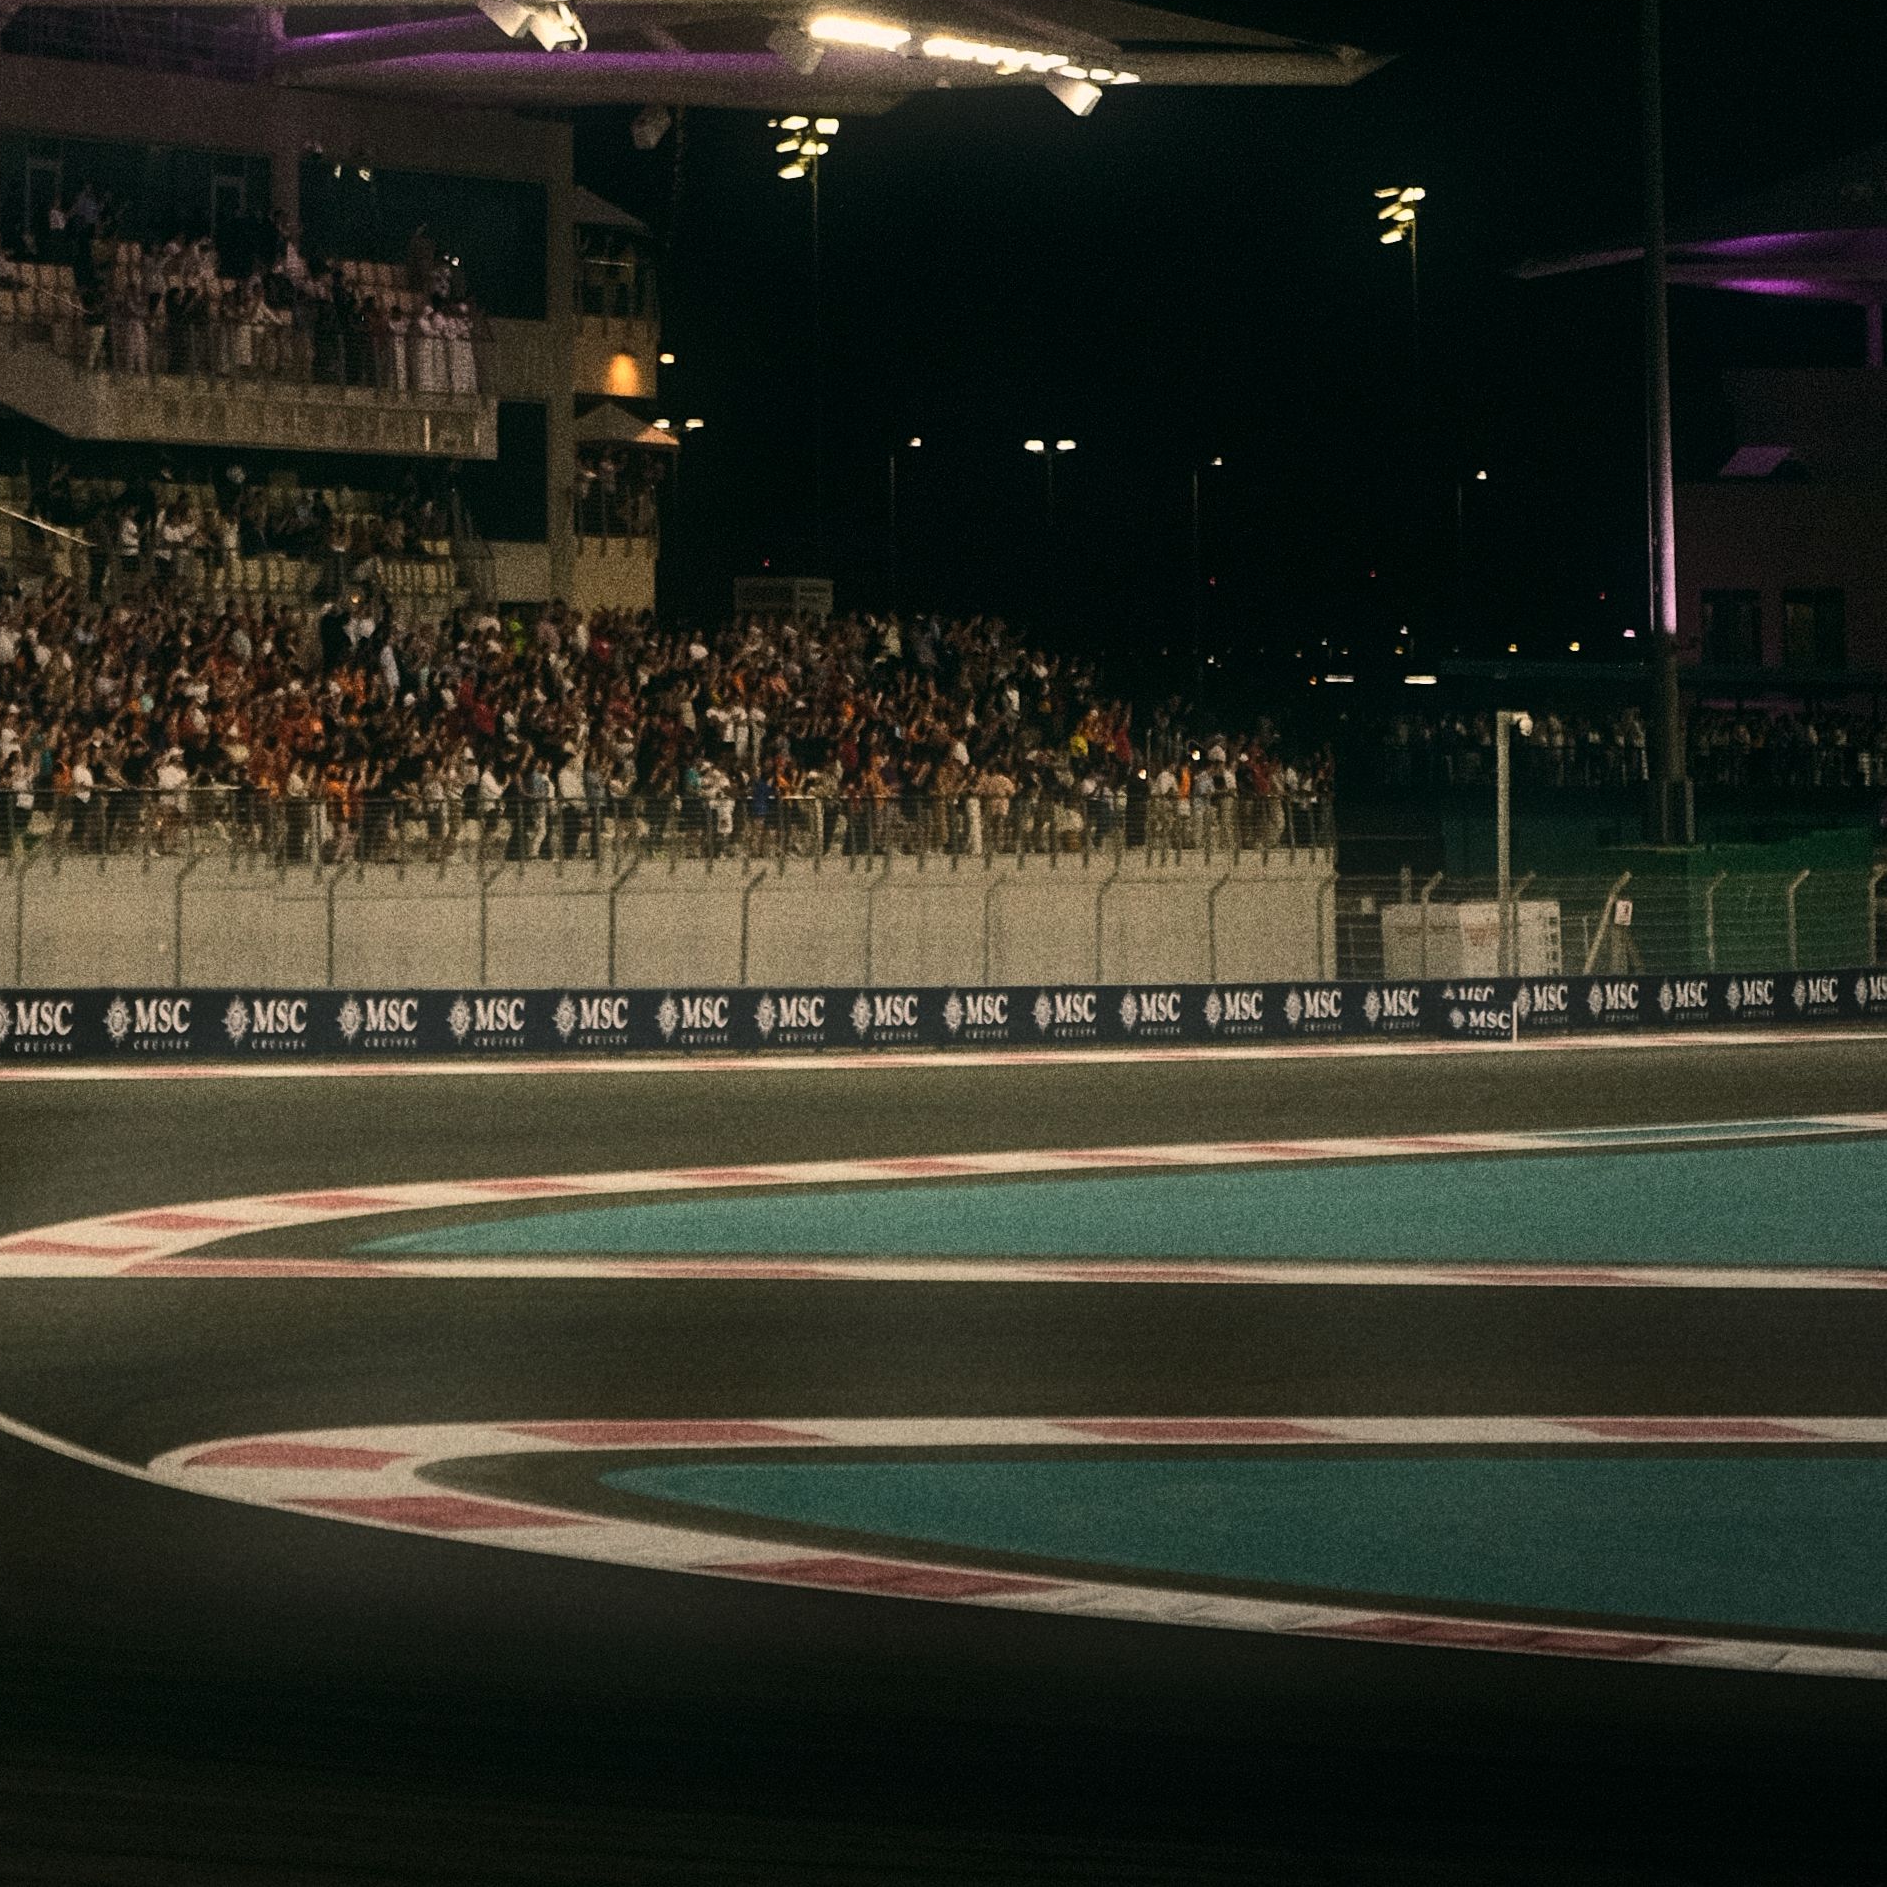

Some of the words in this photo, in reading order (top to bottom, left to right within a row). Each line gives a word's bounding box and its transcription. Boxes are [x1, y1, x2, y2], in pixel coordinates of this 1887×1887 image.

[1382, 988, 1420, 1017] MSC
[1533, 984, 1568, 1011] MSC
[1604, 982, 1639, 1010] MSC
[1674, 981, 1708, 1008] MSC
[1742, 979, 1774, 1006] MSC
[1808, 977, 1838, 1003] MSC
[1869, 975, 1887, 1000] MS
[15, 1000, 73, 1036] MSC
[134, 999, 191, 1034] MSC
[252, 999, 307, 1034] MSC
[365, 998, 418, 1032] MSC
[475, 998, 525, 1031] MSC
[579, 997, 629, 1030] MSC
[681, 996, 729, 1029] MSC
[779, 996, 825, 1028] MSC
[874, 995, 918, 1027] MSC
[965, 994, 1008, 1025] MSC
[1054, 993, 1096, 1023] MSC
[1140, 992, 1181, 1022] MSC
[1224, 991, 1263, 1021] MSC
[1303, 989, 1342, 1019] MSC
[1468, 1008, 1511, 1029] MSC
